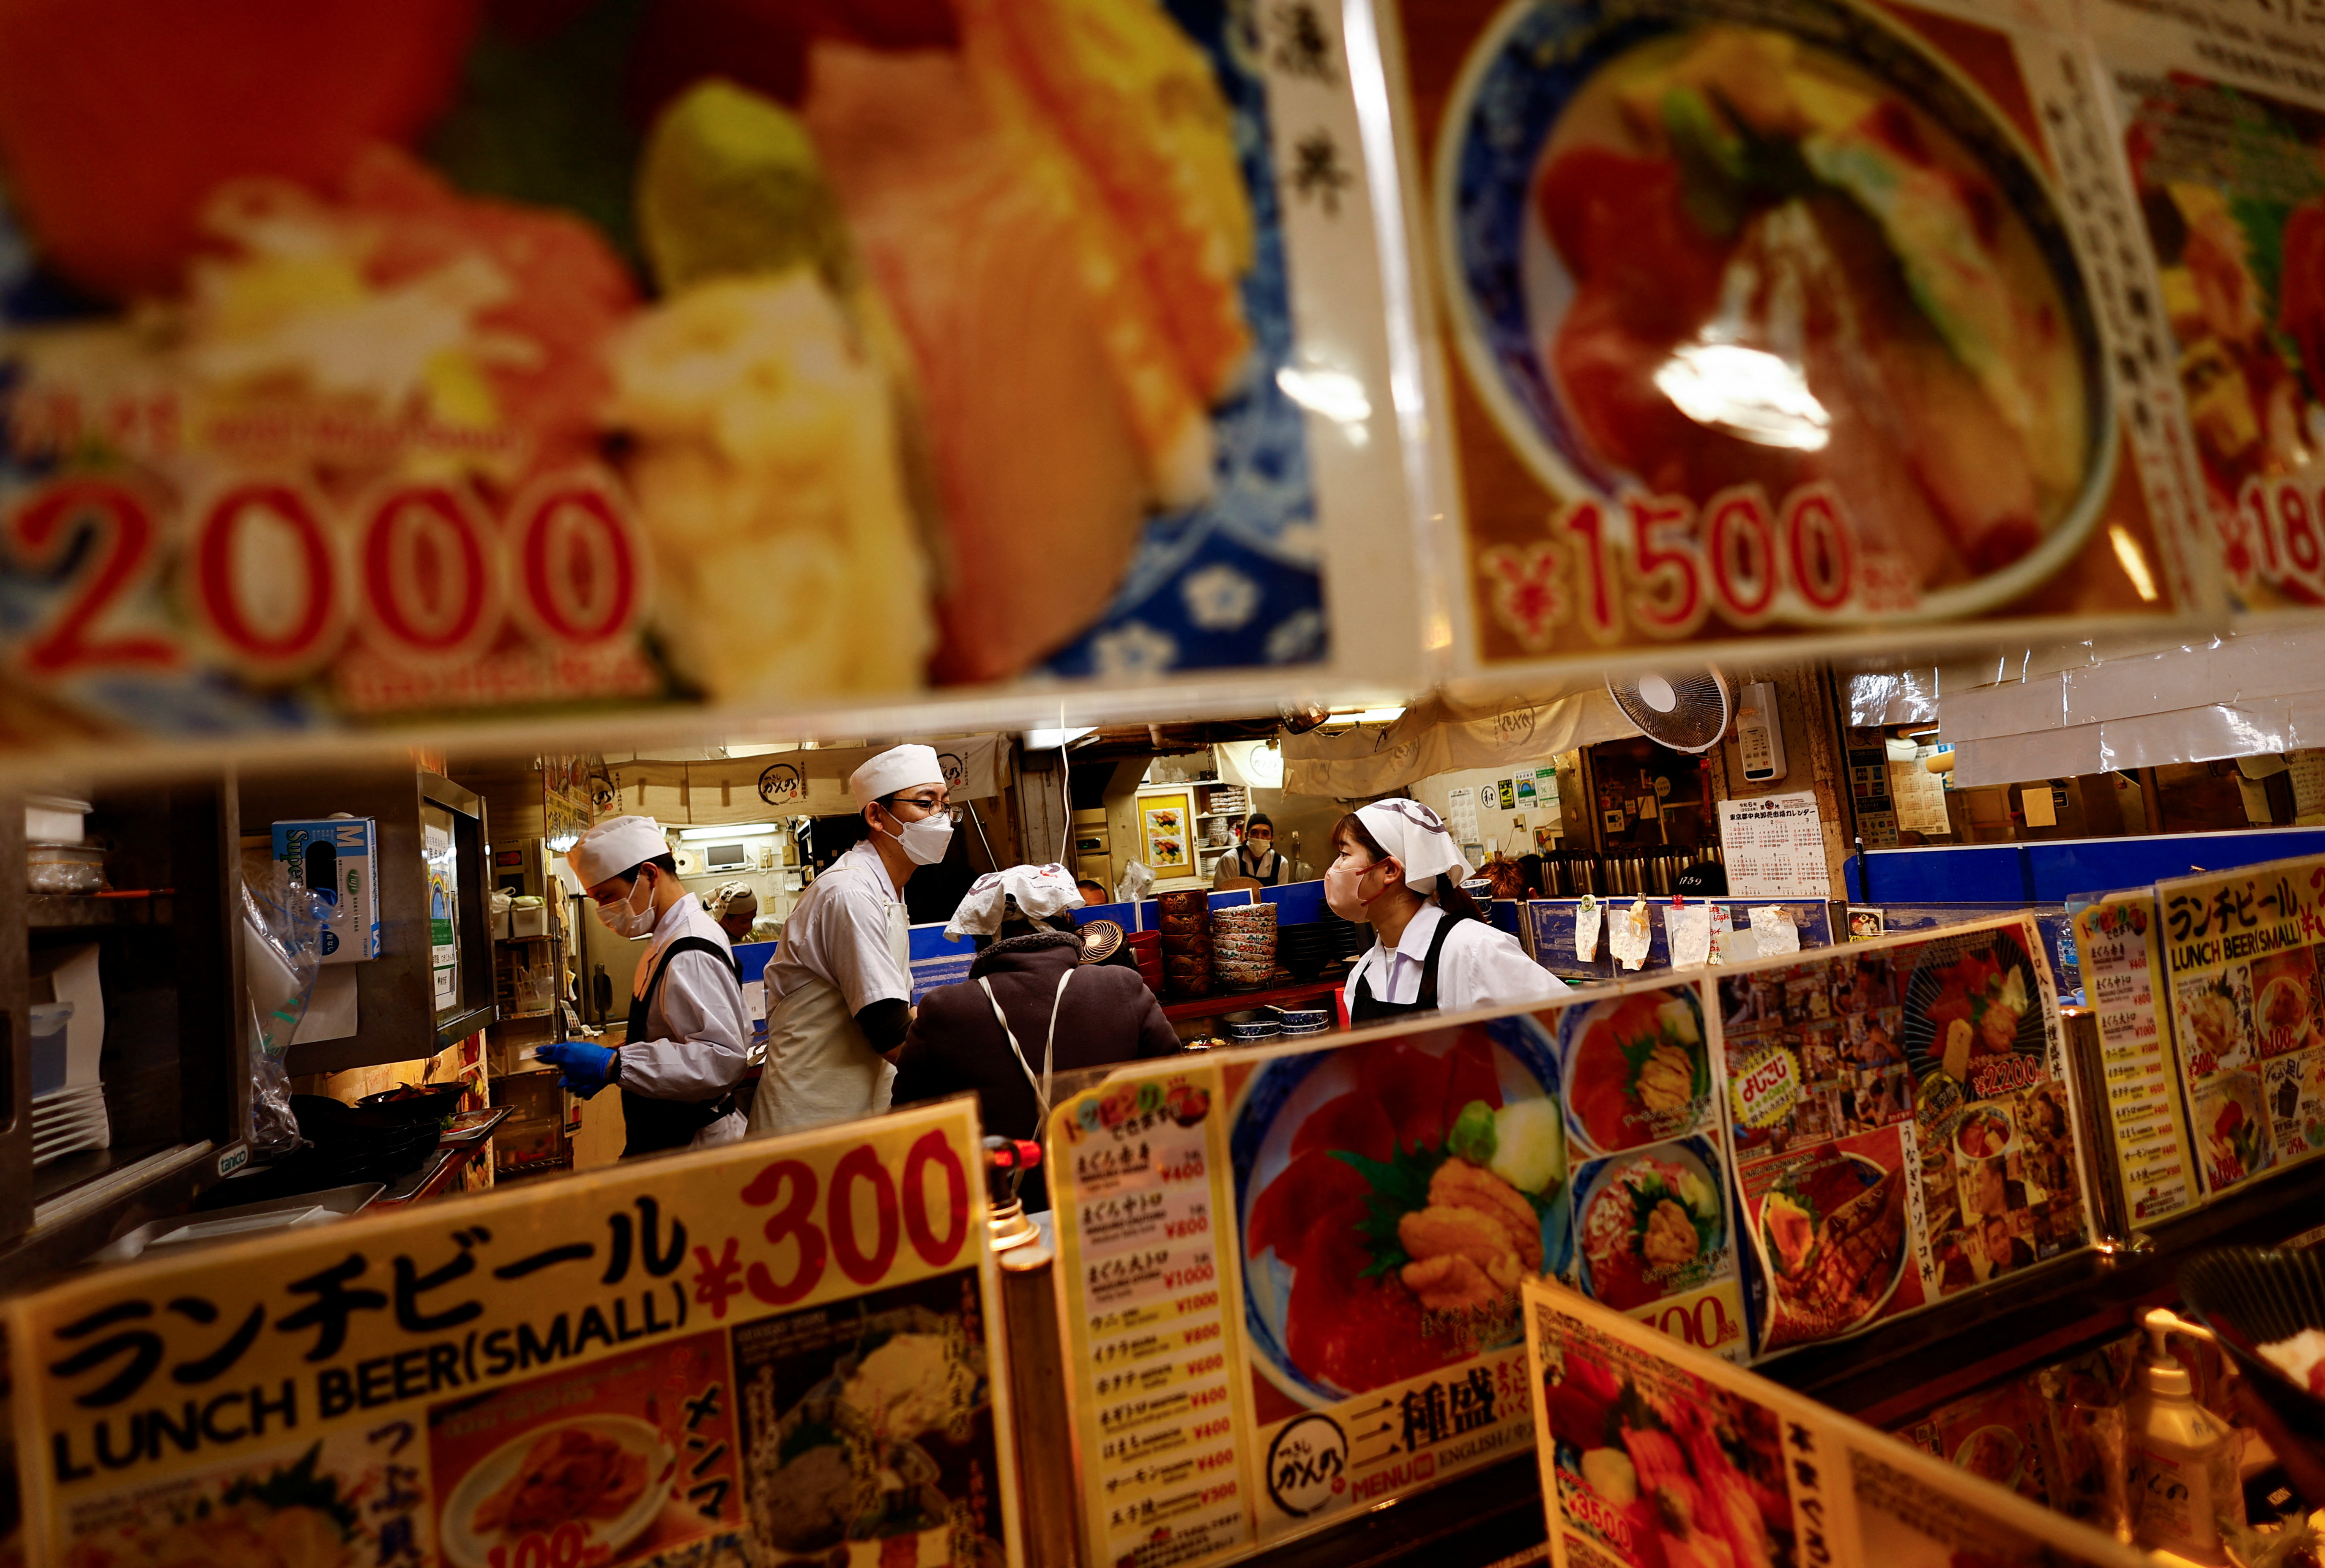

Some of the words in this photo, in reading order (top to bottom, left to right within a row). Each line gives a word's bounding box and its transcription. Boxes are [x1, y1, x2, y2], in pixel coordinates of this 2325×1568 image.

[2218, 482, 2325, 585] ¥18
[1491, 489, 1854, 642] ¥1500
[1483, 789, 1493, 805] 和
[1730, 809, 1816, 821] 東京都中央卸売市場カレンダー
[336, 825, 364, 848] M
[280, 829, 309, 887] Super
[2168, 877, 2297, 941] ランチビール
[2082, 909, 2127, 938] トッピング
[2091, 942, 2125, 958] まぐろ赤身
[2171, 940, 2220, 972] LUNCH
[2224, 920, 2302, 959] BEER(SMALL)
[2129, 958, 2147, 970] ¥400
[2096, 976, 2131, 990] まぐろ中トロ
[2024, 922, 2062, 1079] 中トロ入り三種盛丼
[2133, 993, 2151, 1005] ¥800
[2101, 1013, 2136, 1028] まぐろ大トロ
[2135, 1024, 2156, 1038] ¥1000
[2141, 1042, 2159, 1054] ¥1000
[2262, 1026, 2291, 1055] ¥100
[1973, 1055, 2038, 1097] ¥2200
[2108, 1066, 2123, 1079] イクラ
[2145, 1063, 2161, 1074] ¥800
[2189, 1052, 2213, 1078] ¥500
[1743, 1056, 1786, 1102] よじごじ
[2149, 1083, 2165, 1095] ¥600
[2112, 1086, 2129, 1099] ホタテ
[2115, 1106, 2136, 1120] ネギトロ
[2154, 1103, 2169, 1115] ¥400
[2119, 1126, 2136, 1139] はまち
[2157, 1123, 2173, 1135] ¥400
[221, 1150, 246, 1172] tanico
[2124, 1148, 2147, 1161] サーモン
[2162, 1144, 2177, 1156] ¥400
[1161, 1163, 1205, 1184] ¥400
[1083, 1192, 1163, 1226] まぐろ中トロ
[1903, 1125, 1935, 1283] うなぎメソッコ丼
[692, 1128, 970, 1319] ¥300
[1088, 1248, 1169, 1284] まぐろ大トロ
[1164, 1266, 1214, 1289] ¥1000
[51, 1196, 687, 1407] ランチビール
[1176, 1291, 1219, 1314] ¥1000
[1640, 1296, 1726, 1348] 00
[53, 1379, 297, 1484] LUNCH
[319, 1280, 689, 1420] BEER(SMALL)
[1096, 1370, 1138, 1396] ホタテ
[1190, 1385, 1228, 1409] ¥400
[1193, 1417, 1231, 1441] ¥400
[1350, 1365, 1497, 1469] 三種盛
[685, 1385, 732, 1518] メンマ
[1438, 1429, 1502, 1467] ENGLISH
[1197, 1449, 1234, 1472] ¥400
[1106, 1463, 1159, 1494] サーモン
[1351, 1461, 1412, 1503] MENU
[1200, 1481, 1237, 1505] ¥300
[2266, 1486, 2293, 1508] KIRIN
[1569, 1492, 1632, 1549] ¥3500
